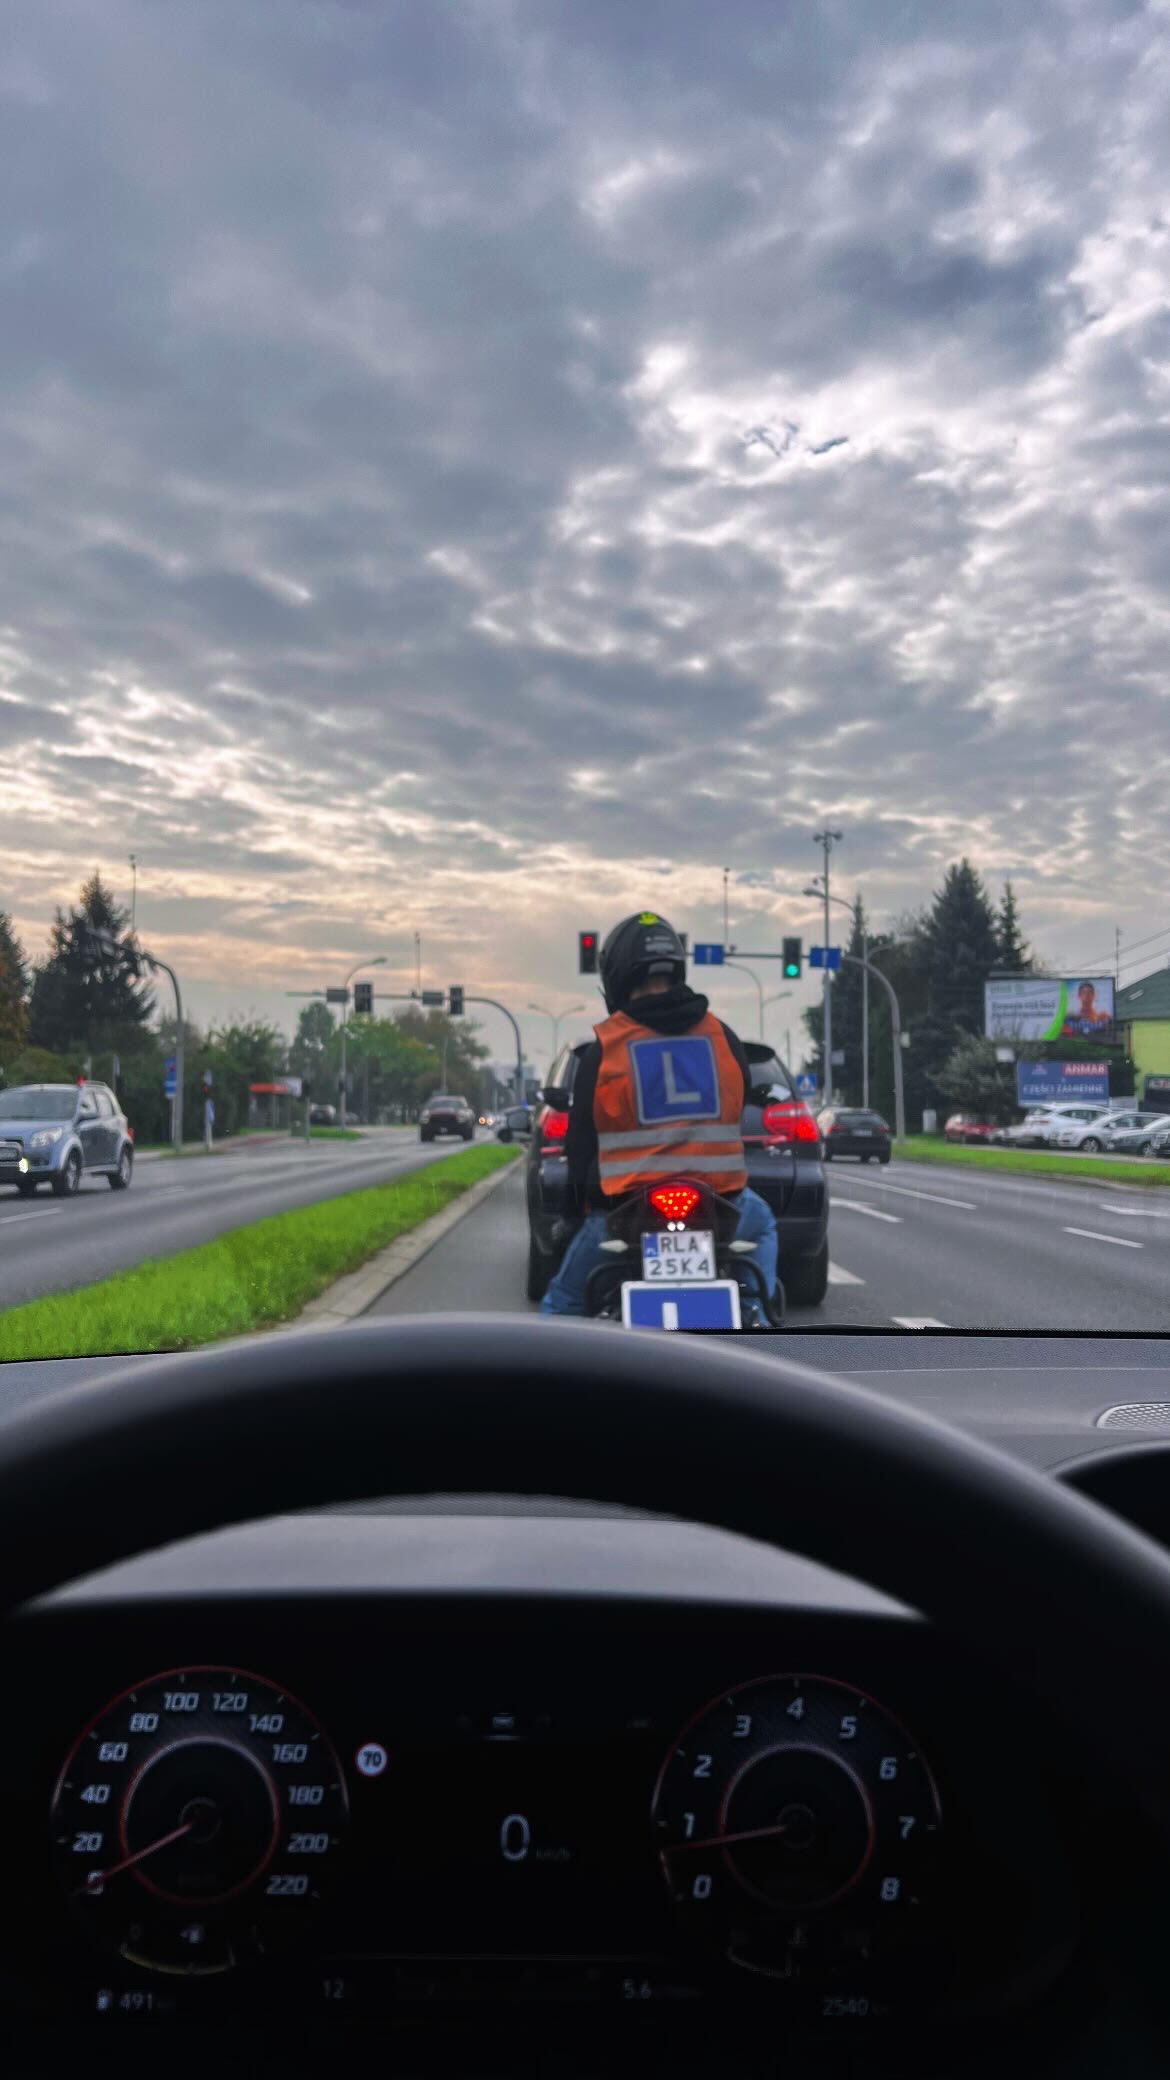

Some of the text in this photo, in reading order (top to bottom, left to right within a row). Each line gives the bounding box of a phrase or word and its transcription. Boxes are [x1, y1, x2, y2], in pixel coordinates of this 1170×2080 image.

[662, 1051, 701, 1104] L
[661, 1236, 699, 1253] RLA
[649, 1259, 710, 1276] 25K4
[165, 1693, 199, 1711] 100
[213, 1693, 247, 1711] 120
[787, 1697, 803, 1718] 4
[130, 1713, 159, 1732] 80
[250, 1714, 284, 1732] 140
[734, 1715, 751, 1736] 3
[840, 1716, 856, 1738] 5
[99, 1743, 128, 1761] 60
[273, 1744, 307, 1762] 160
[363, 1750, 381, 1767] 70
[694, 1755, 712, 1777] 2
[880, 1757, 896, 1779] 6
[81, 1785, 110, 1803] 40
[289, 1786, 323, 1804] 180
[685, 1813, 695, 1836] 1
[900, 1816, 915, 1838] 7
[73, 1832, 102, 1851] 20
[288, 1834, 328, 1852] 200
[501, 1814, 529, 1860] 0
[267, 1875, 308, 1894] 220
[693, 1875, 712, 1898] 0
[881, 1878, 899, 1900] 8
[324, 1979, 344, 1999] 12
